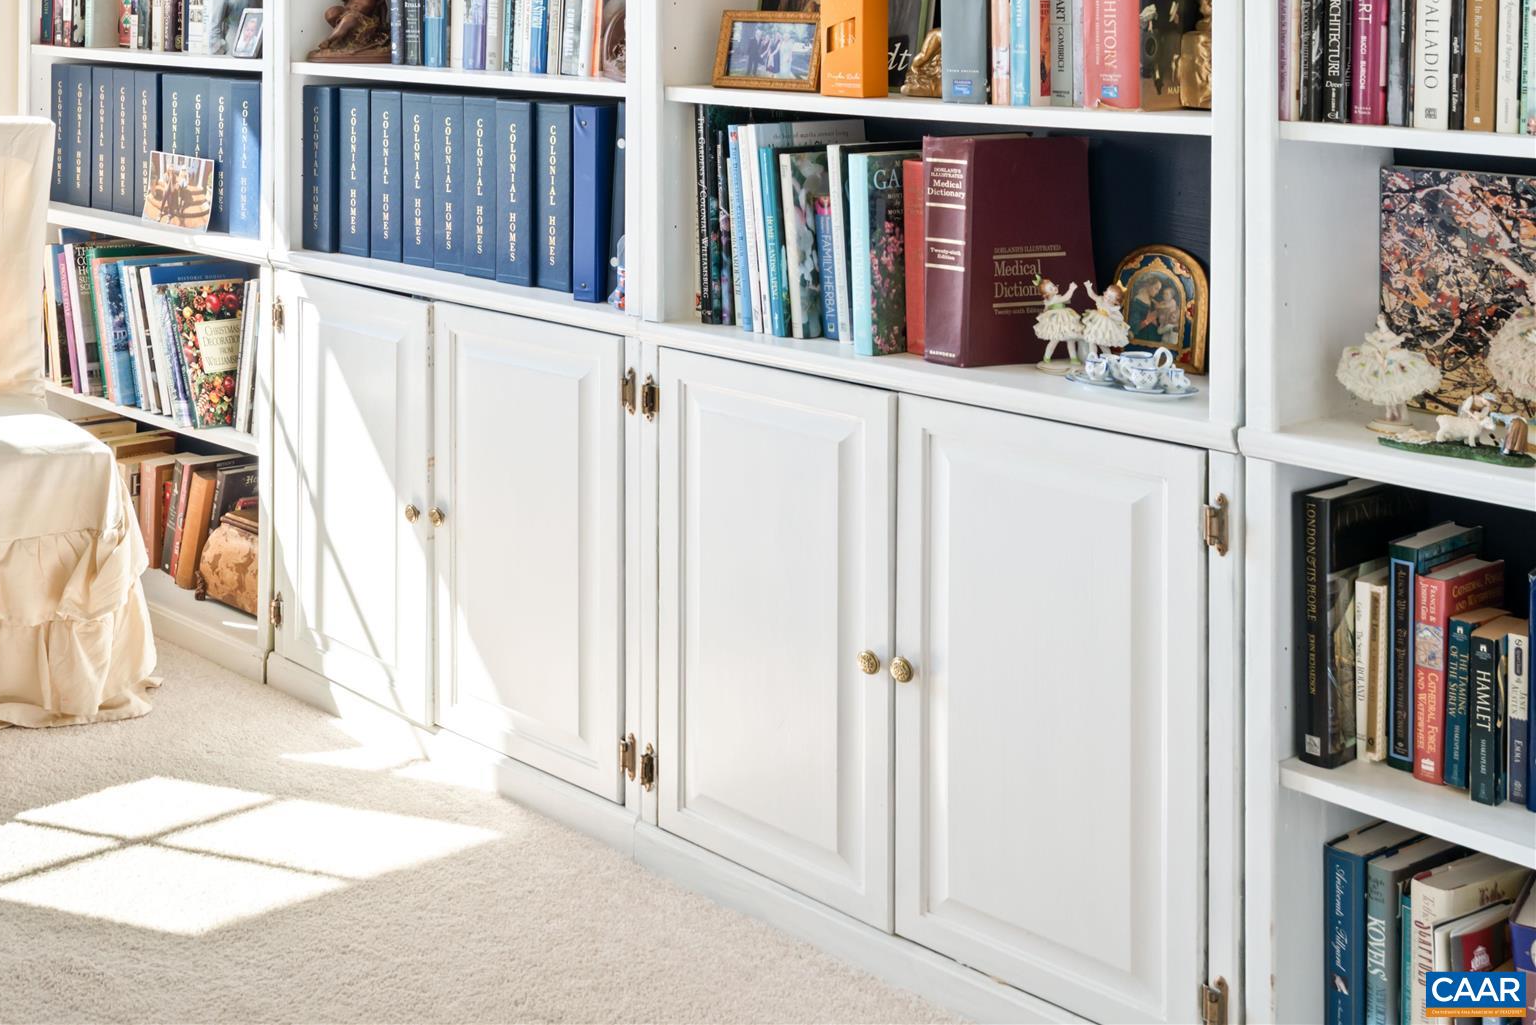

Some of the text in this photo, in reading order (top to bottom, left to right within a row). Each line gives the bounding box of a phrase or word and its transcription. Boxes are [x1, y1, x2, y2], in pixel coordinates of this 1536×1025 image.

[1056, 0, 1064, 21] ART
[1103, 0, 1116, 69] HISTORY
[698, 136, 706, 177] GARDENS
[240, 178, 248, 220] HOMES
[927, 188, 966, 199] Dictionary
[933, 180, 962, 189] Medical
[823, 234, 835, 320] FAMILY HERBAL
[995, 260, 1041, 277] Medical
[1306, 502, 1316, 551] LONDON
[1306, 581, 1317, 621] PEOPLE
[1448, 645, 1459, 717] OF THE SHREW
[1458, 653, 1469, 715] THE TAMING
[1476, 670, 1491, 732] HAMLET
[1514, 739, 1523, 763] EMMA
